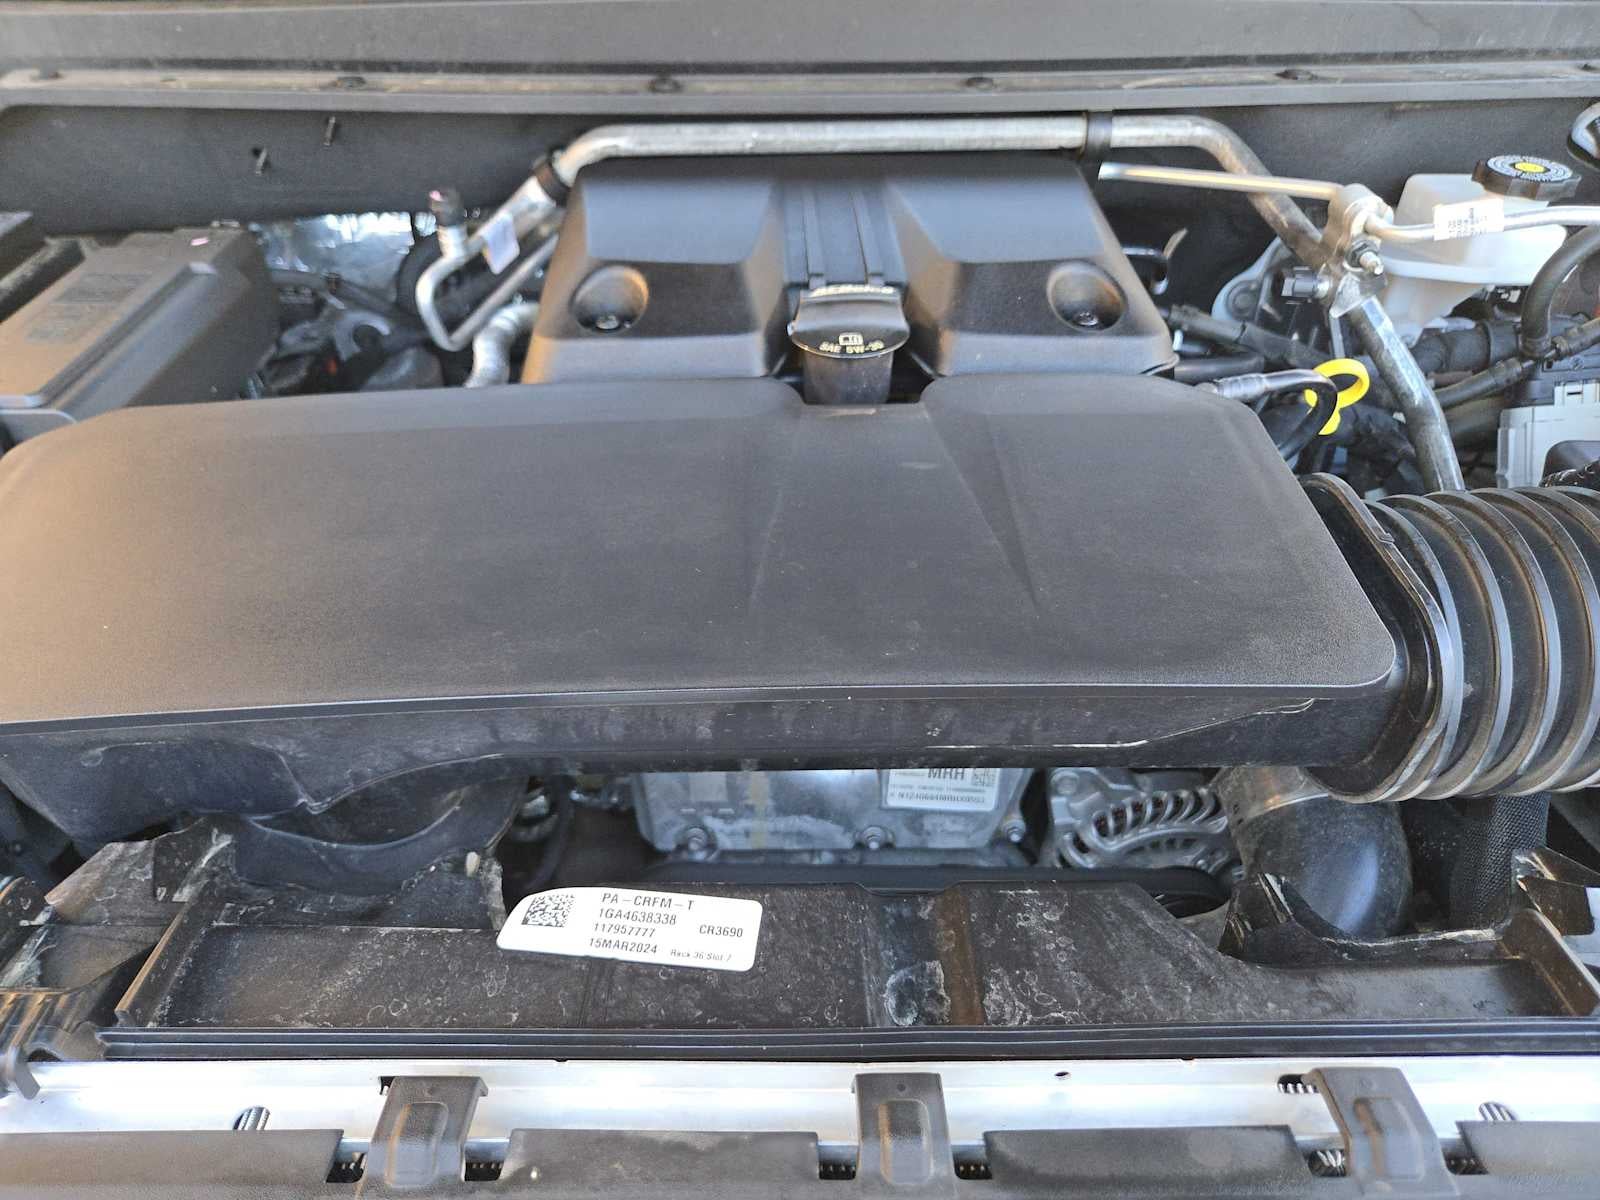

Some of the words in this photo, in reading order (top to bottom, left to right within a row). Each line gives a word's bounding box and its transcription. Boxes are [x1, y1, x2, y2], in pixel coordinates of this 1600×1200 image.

[599, 908, 677, 926] 1GA4638338
[594, 922, 656, 938] 117957777
[699, 924, 744, 938] CR3690
[589, 938, 658, 954] 15MAR2024
